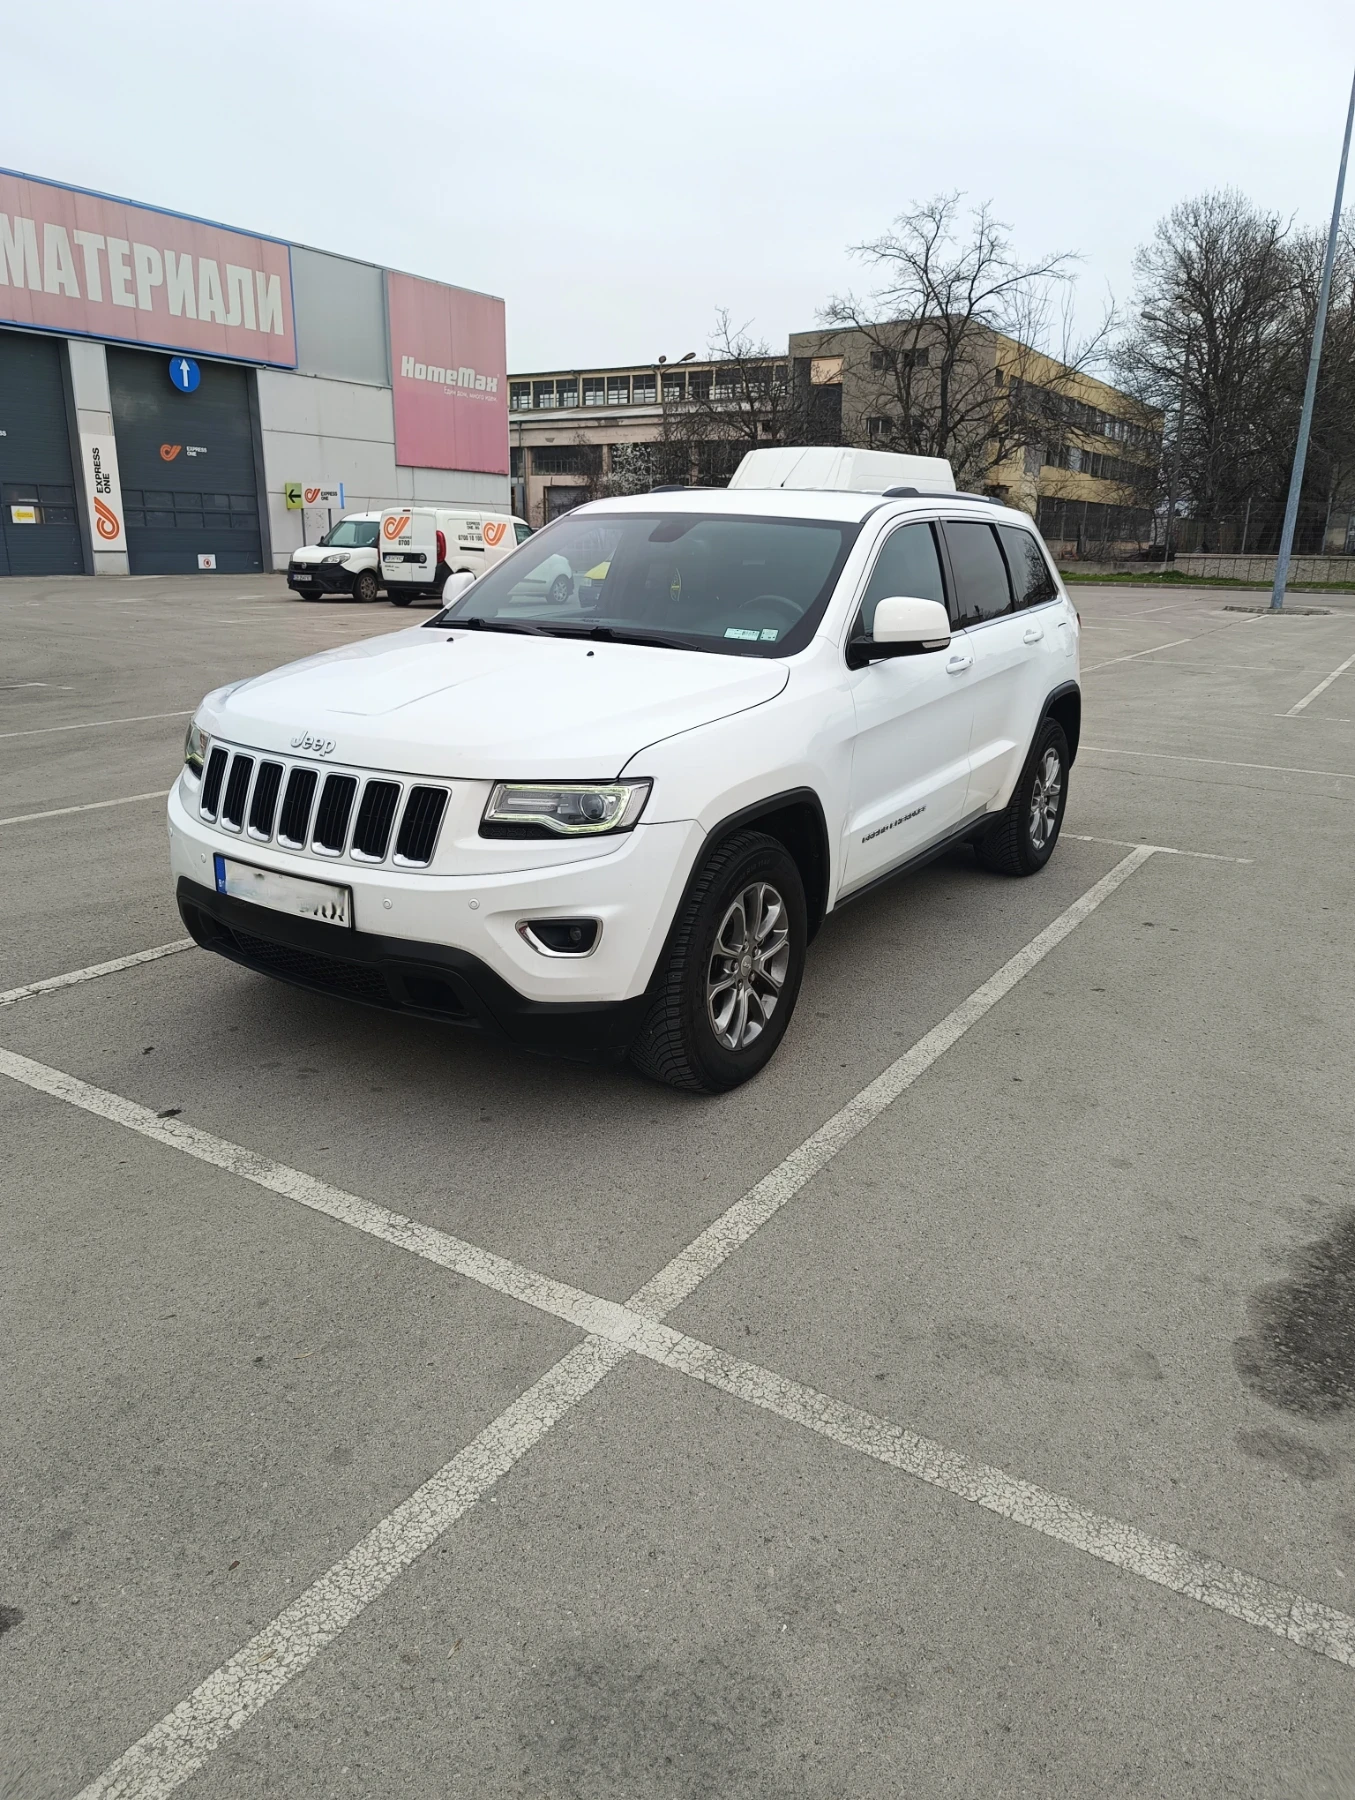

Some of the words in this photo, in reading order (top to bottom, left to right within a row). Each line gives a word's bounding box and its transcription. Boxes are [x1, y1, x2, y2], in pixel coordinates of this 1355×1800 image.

[0, 213, 284, 336] МАТЕРИАЛИ
[401, 355, 498, 393] HomeMax
[92, 447, 104, 494] EXPRESS
[102, 473, 111, 494] ONE
[290, 730, 336, 757] Jeep
